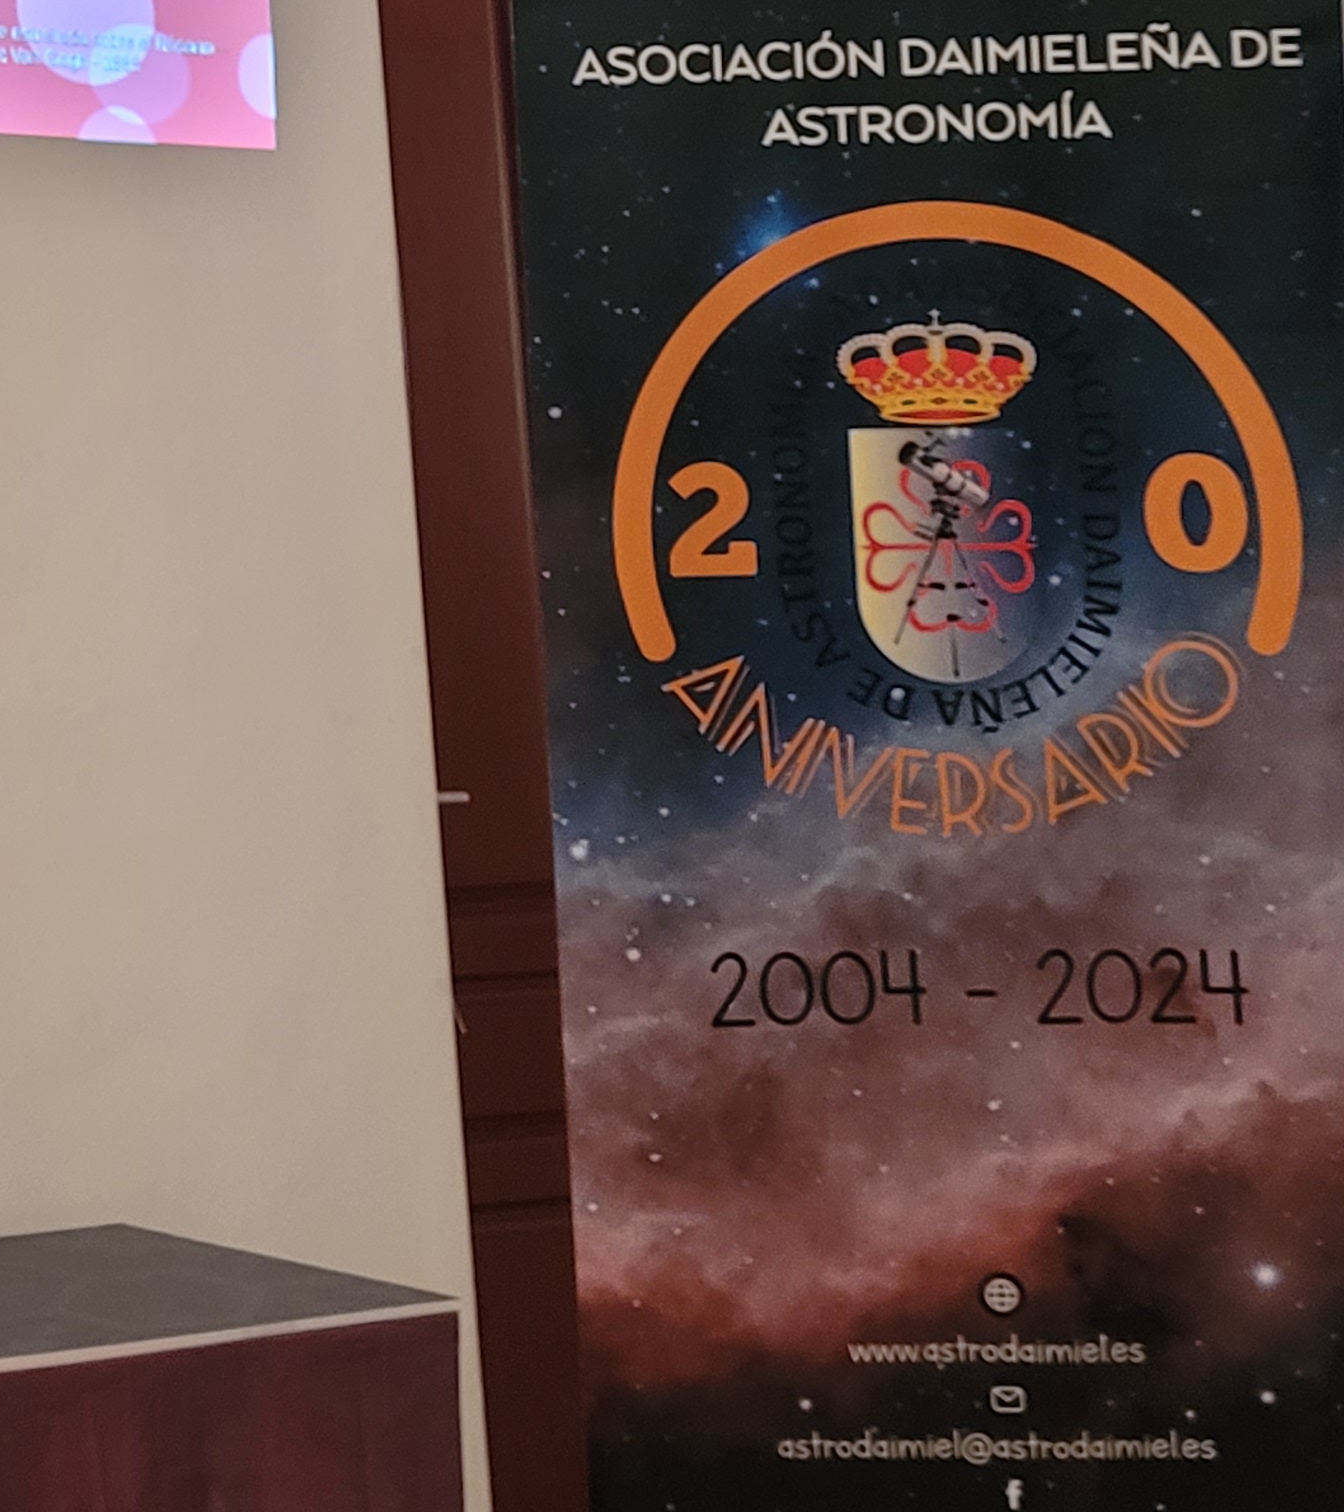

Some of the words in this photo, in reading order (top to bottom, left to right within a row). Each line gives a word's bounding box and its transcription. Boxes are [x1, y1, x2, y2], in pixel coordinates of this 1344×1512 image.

[572, 30, 885, 86] ASOCIACIÓN
[899, 22, 1222, 76] DAIMIELEÑA
[1230, 28, 1304, 68] DE
[762, 90, 1113, 148] ASTRONOMÍA
[931, 513, 1123, 734] DAIMIELEÑA
[662, 632, 1243, 838] ANIVERSARIO
[711, 949, 926, 1028] 2004
[1036, 947, 1250, 1026] 2024
